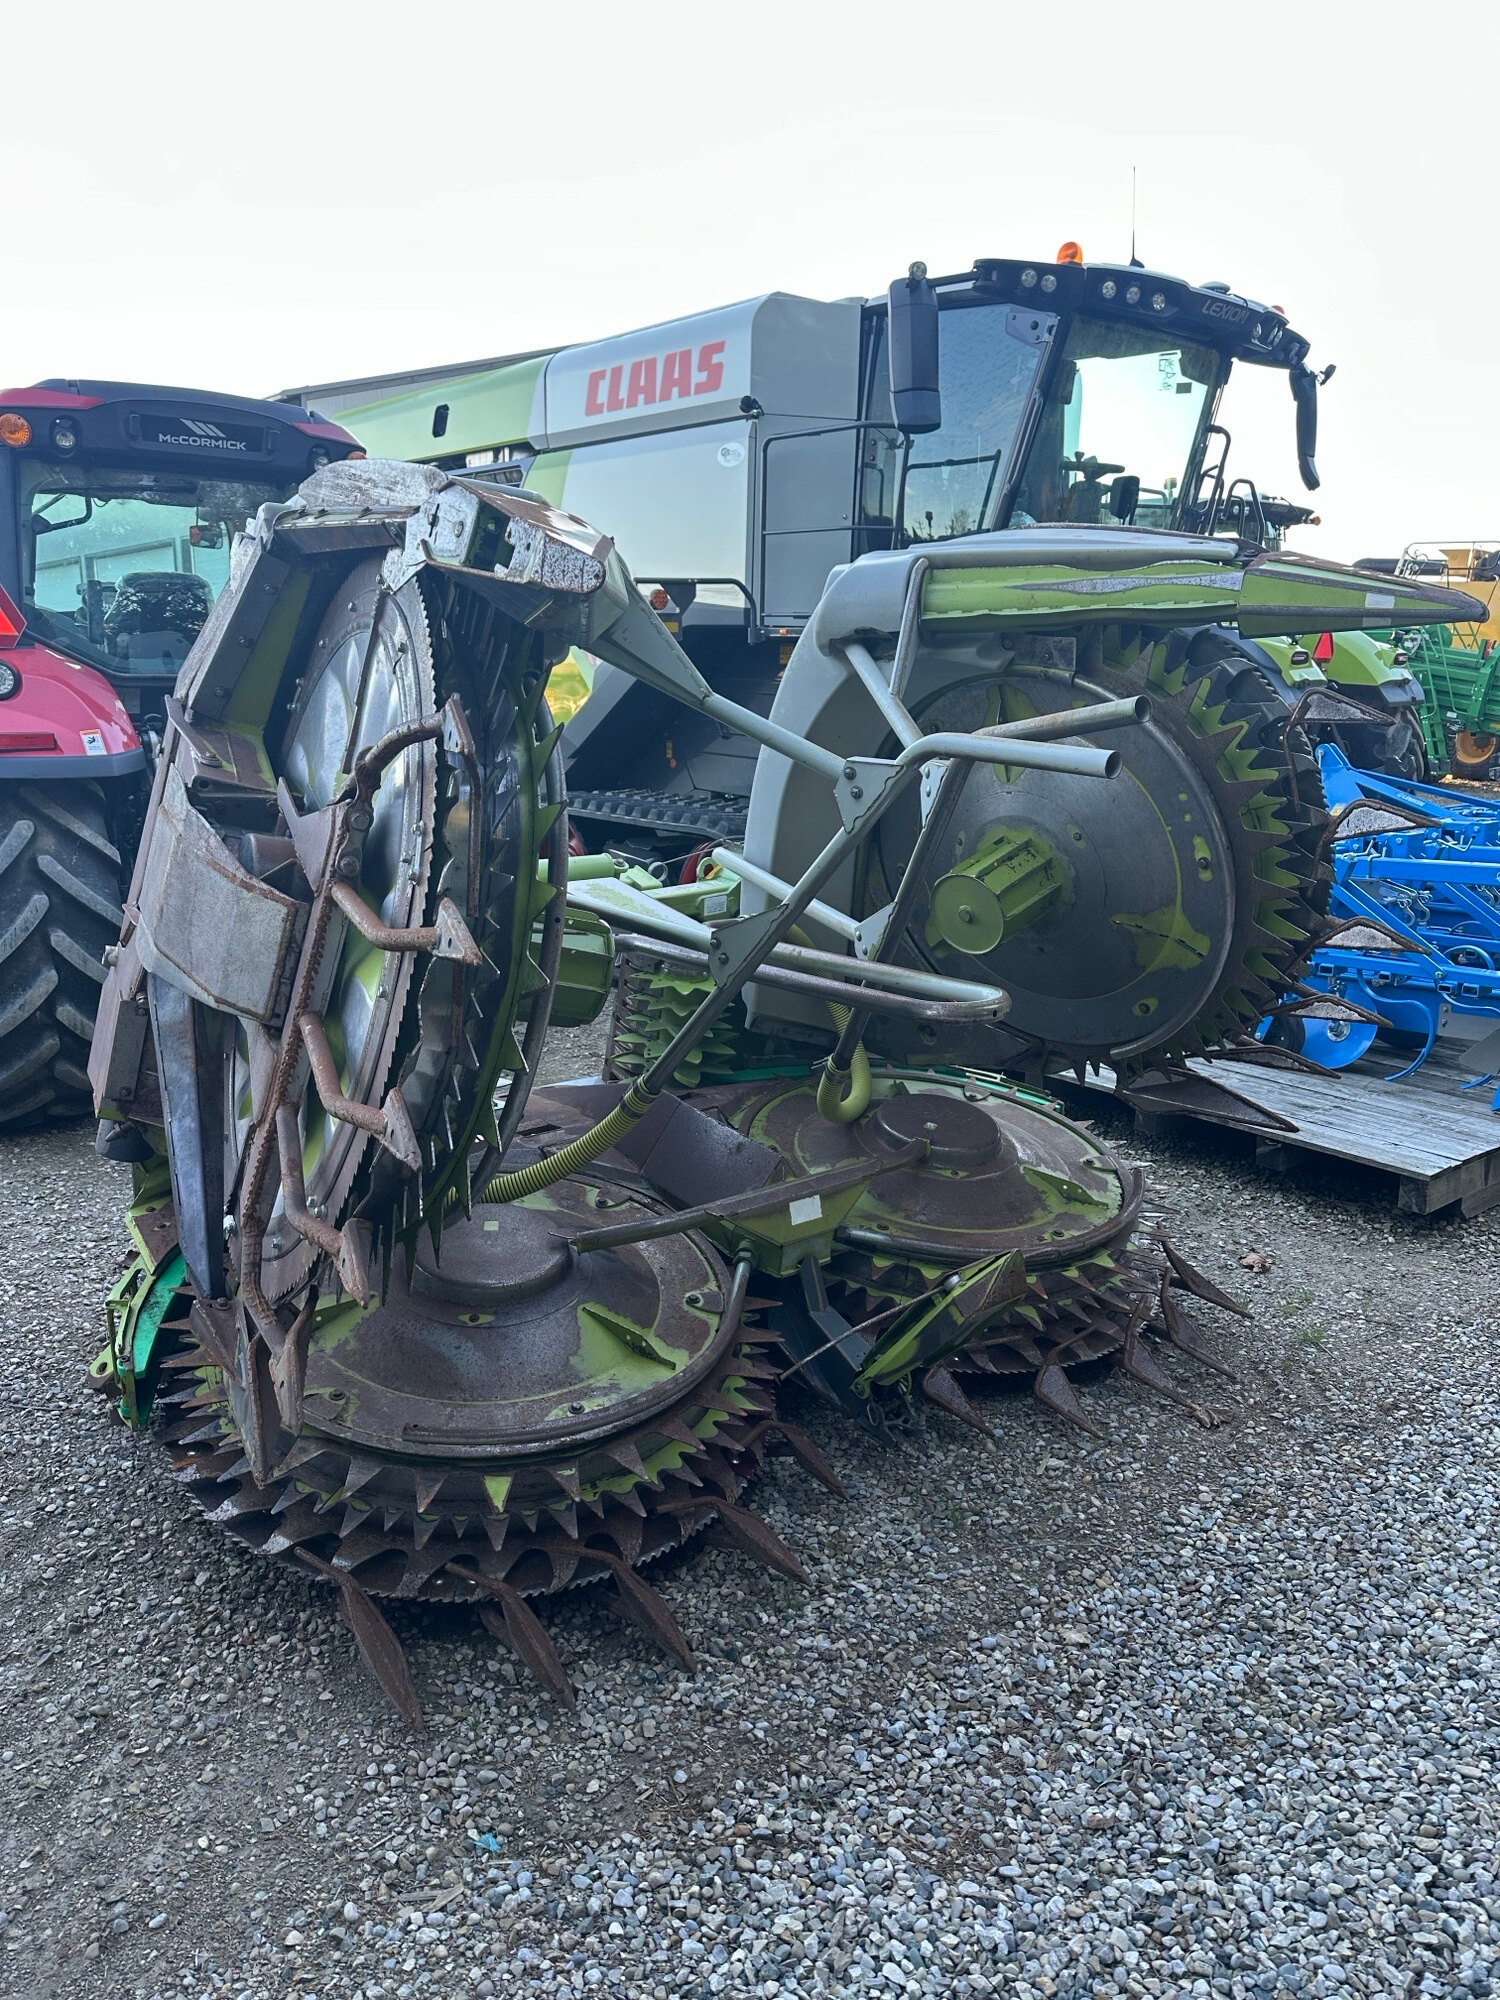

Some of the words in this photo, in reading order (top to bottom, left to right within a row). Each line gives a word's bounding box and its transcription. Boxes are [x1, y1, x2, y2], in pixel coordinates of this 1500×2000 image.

[1201, 299, 1250, 324] LEXION
[585, 340, 726, 417] CLAAS
[159, 433, 247, 451] McCORMICK
